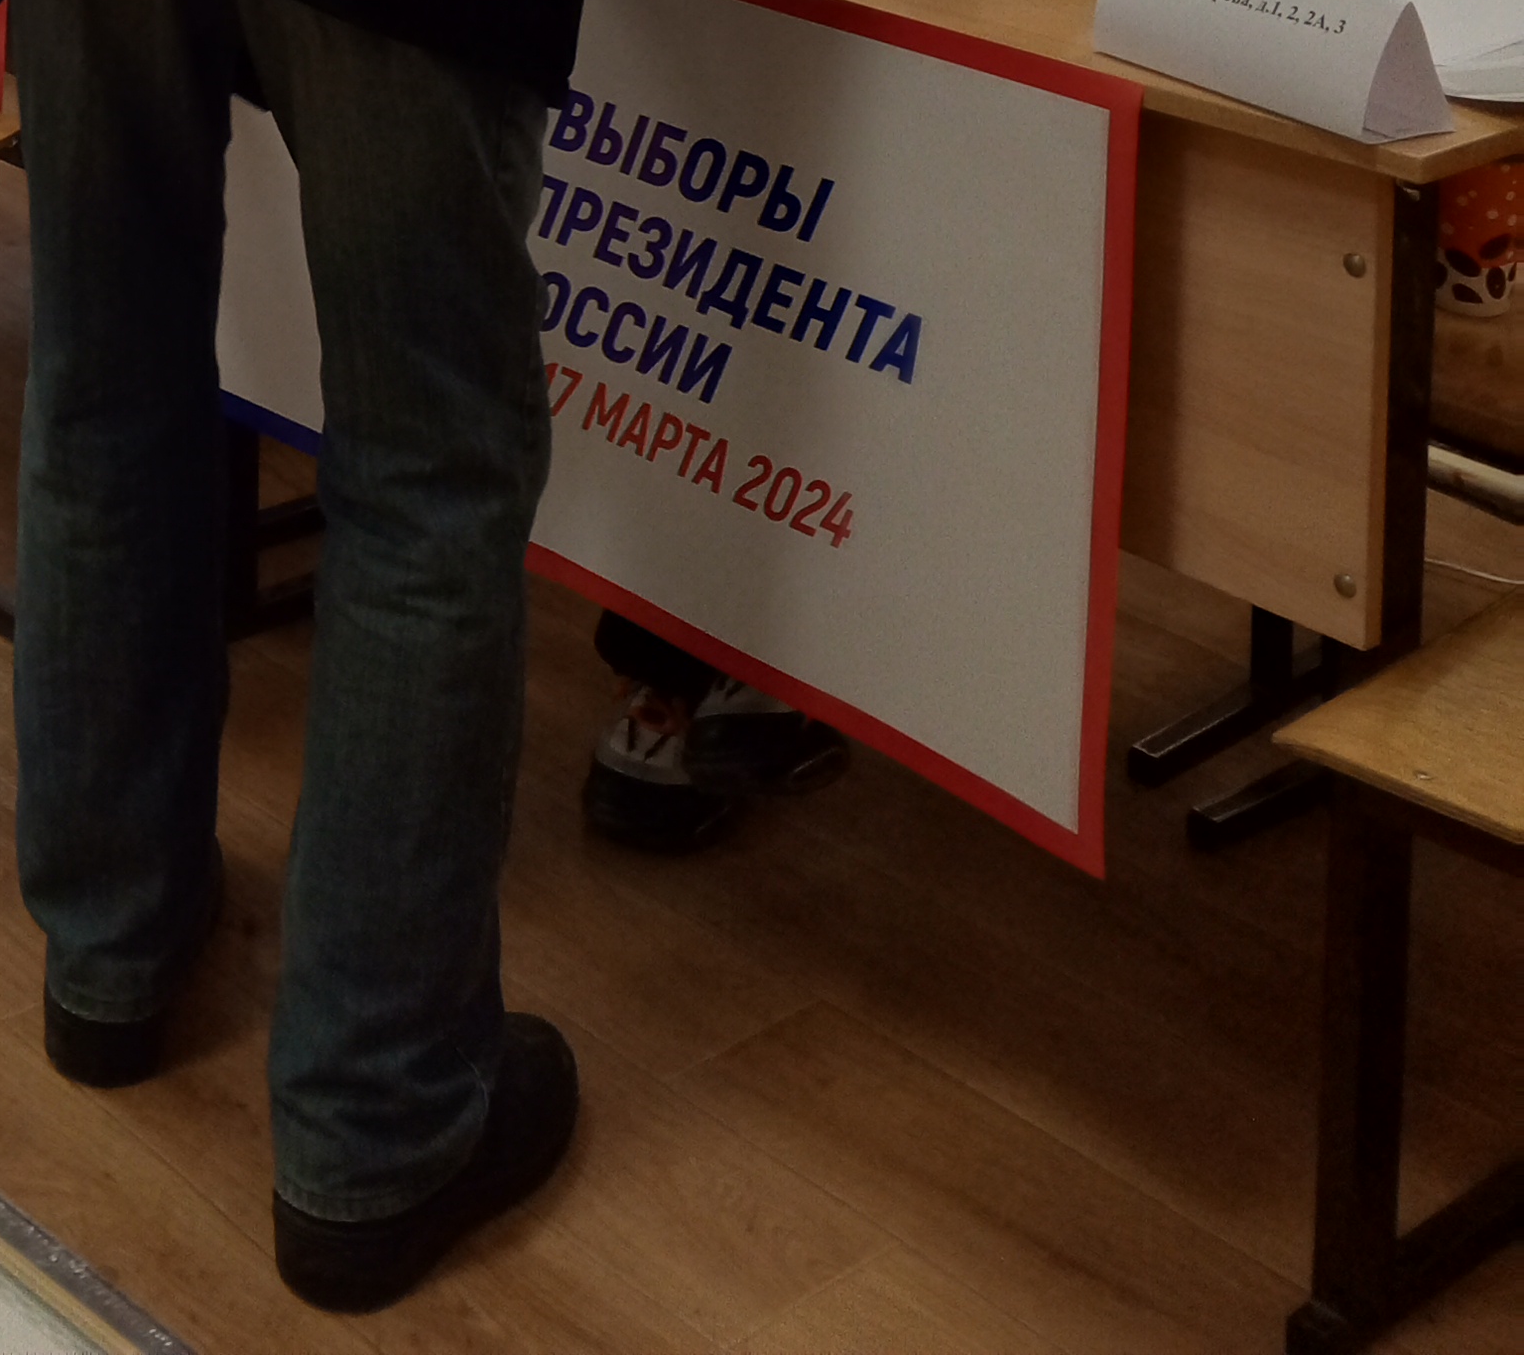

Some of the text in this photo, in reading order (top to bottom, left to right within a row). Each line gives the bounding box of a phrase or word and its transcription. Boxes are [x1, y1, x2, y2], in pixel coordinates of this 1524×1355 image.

[1333, 19, 1347, 34] 3
[549, 89, 835, 242] ВЫБОРЫ
[538, 174, 922, 384] ПРЕЗИДЕНТА
[540, 271, 733, 404] ОССИИ
[582, 382, 728, 494] МАРТА
[733, 455, 853, 549] 2024
